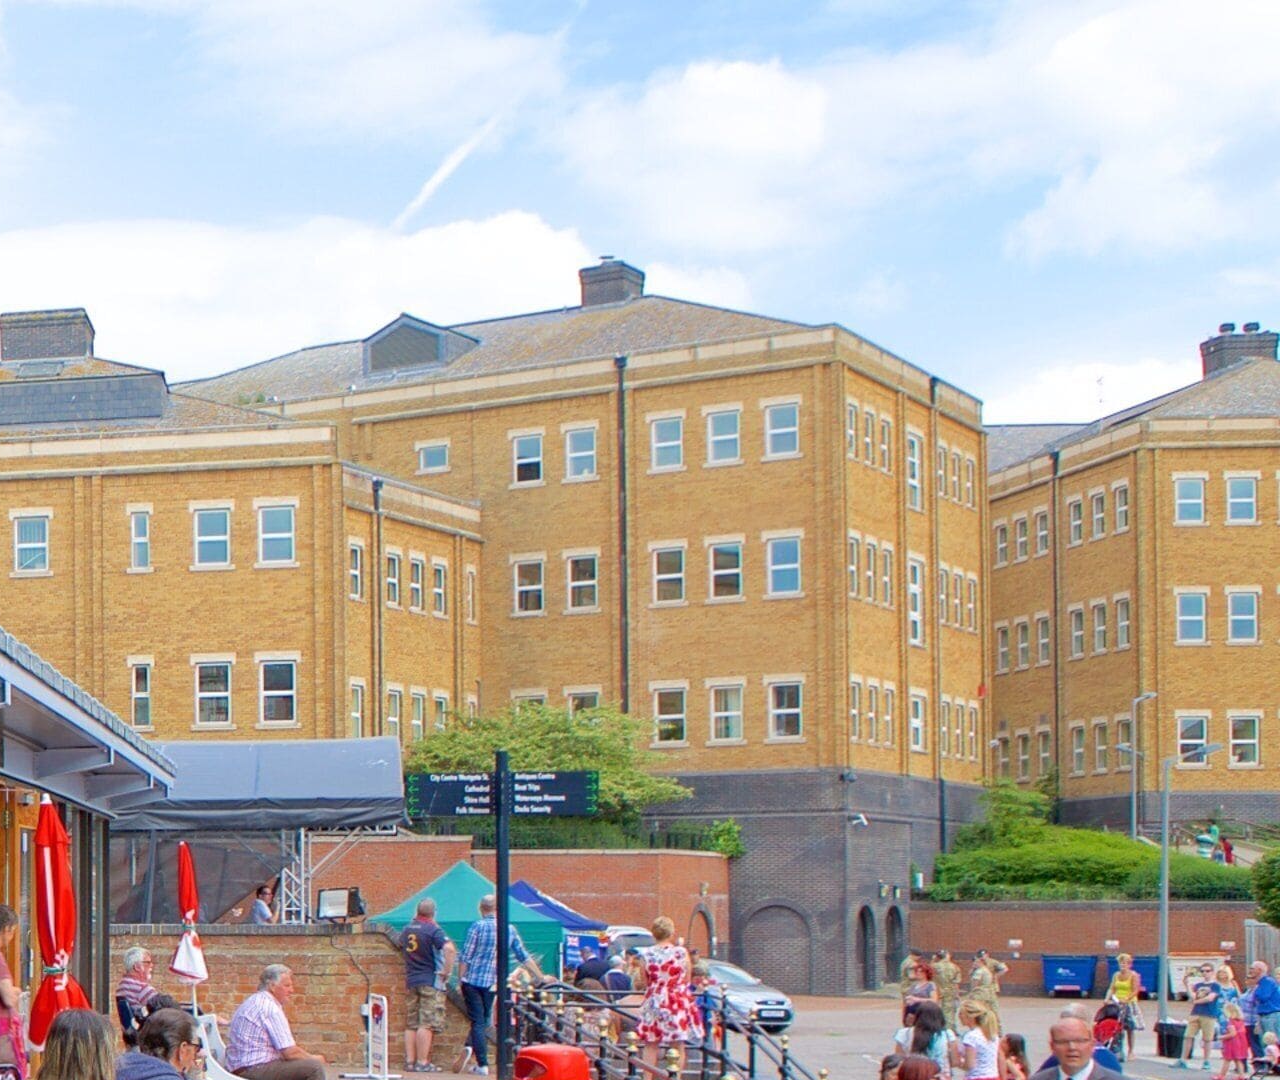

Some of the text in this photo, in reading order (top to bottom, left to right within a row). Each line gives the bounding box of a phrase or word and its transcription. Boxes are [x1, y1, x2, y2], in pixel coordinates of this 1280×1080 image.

[464, 784, 490, 793] Cathedral
[528, 783, 540, 792] Trips
[406, 933, 418, 952] 3
